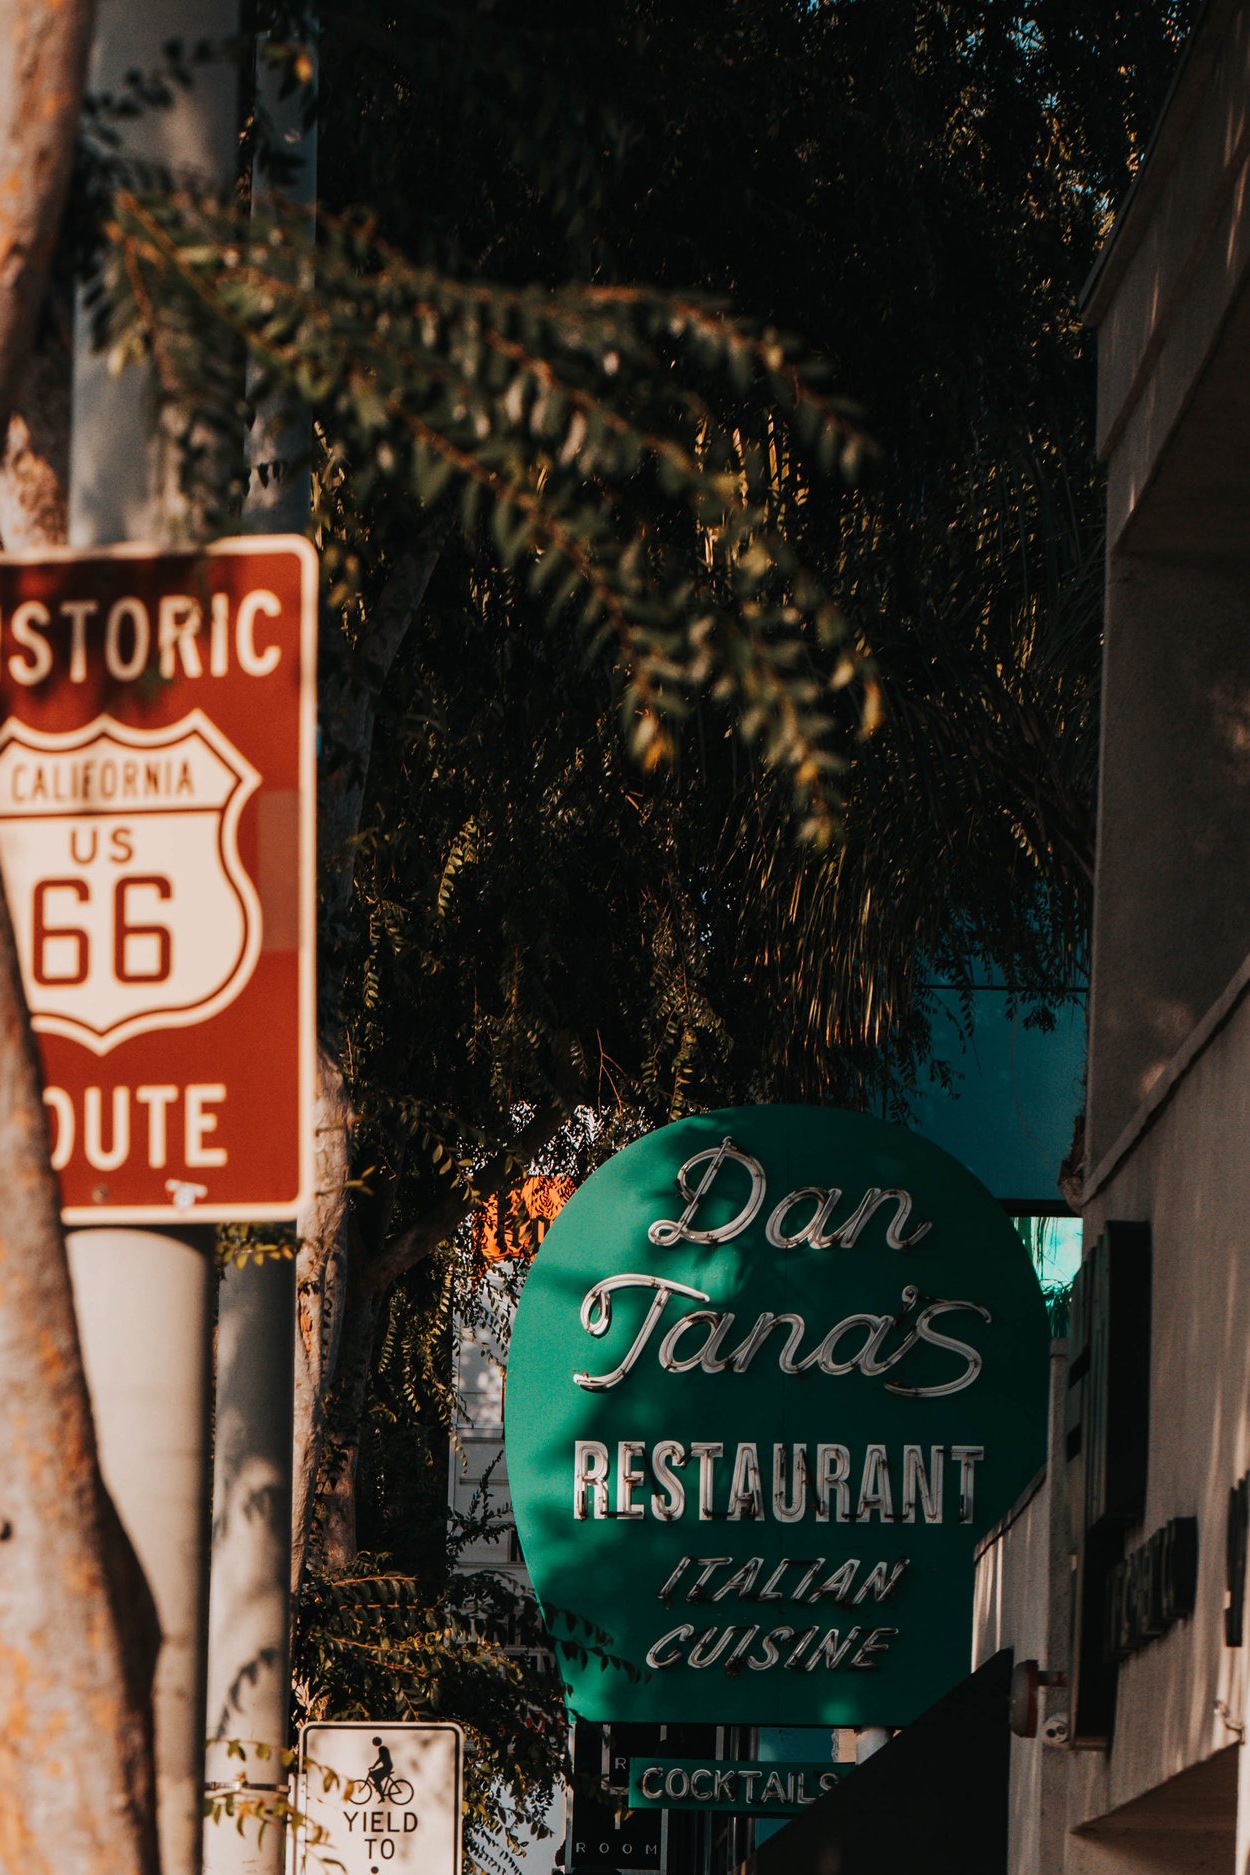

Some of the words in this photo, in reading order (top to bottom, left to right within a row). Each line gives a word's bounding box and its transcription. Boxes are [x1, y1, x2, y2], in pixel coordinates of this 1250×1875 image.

[11, 757, 196, 802] CALIFORNIA
[70, 827, 135, 865] US
[31, 875, 174, 987] 66
[42, 1083, 228, 1172] OUTE
[647, 1136, 933, 1249] Dan
[573, 1440, 985, 1524] RESTAURANT
[657, 1556, 911, 1605] ITALIAN
[645, 1623, 899, 1672] CUISINE
[642, 1767, 840, 1804] COCKTAILS
[343, 1811, 419, 1833] YIELD
[364, 1838, 395, 1860] TO
[576, 1842, 658, 1855] ROOM
